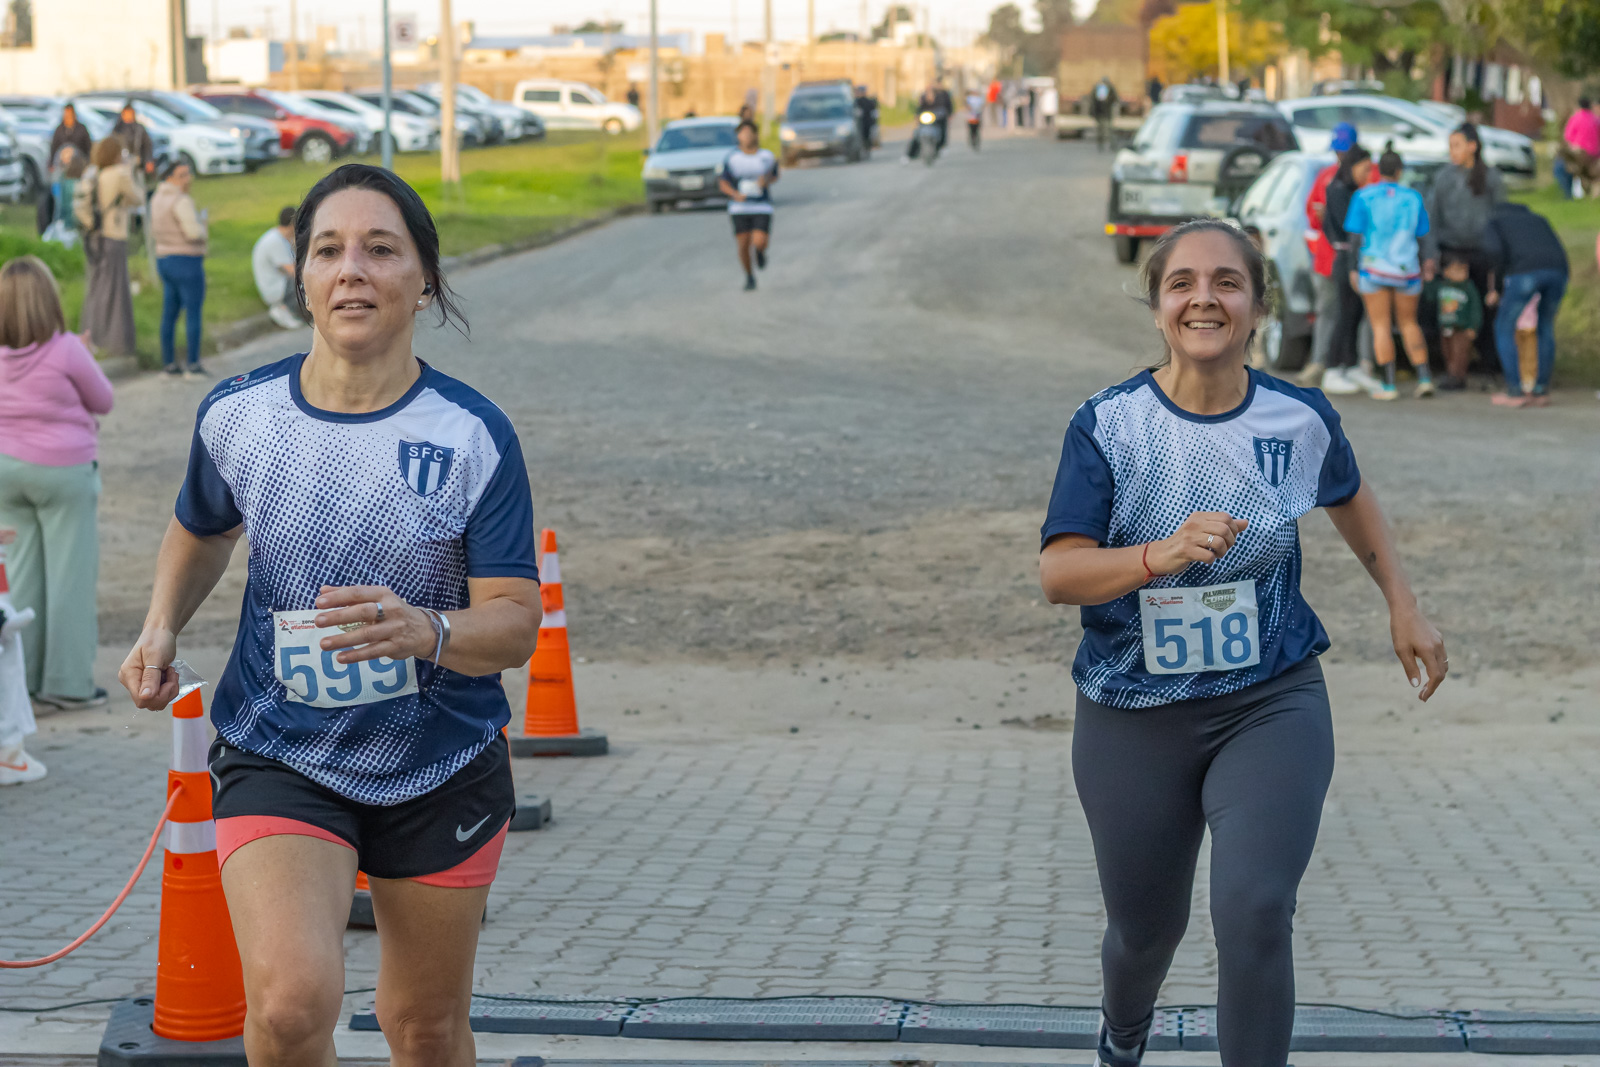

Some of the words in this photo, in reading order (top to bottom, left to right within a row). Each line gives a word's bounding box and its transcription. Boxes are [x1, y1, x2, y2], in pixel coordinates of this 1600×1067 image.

[409, 446, 443, 461] SFC
[1261, 442, 1285, 454] SFC
[1154, 612, 1251, 669] 518
[280, 646, 408, 702] 599
